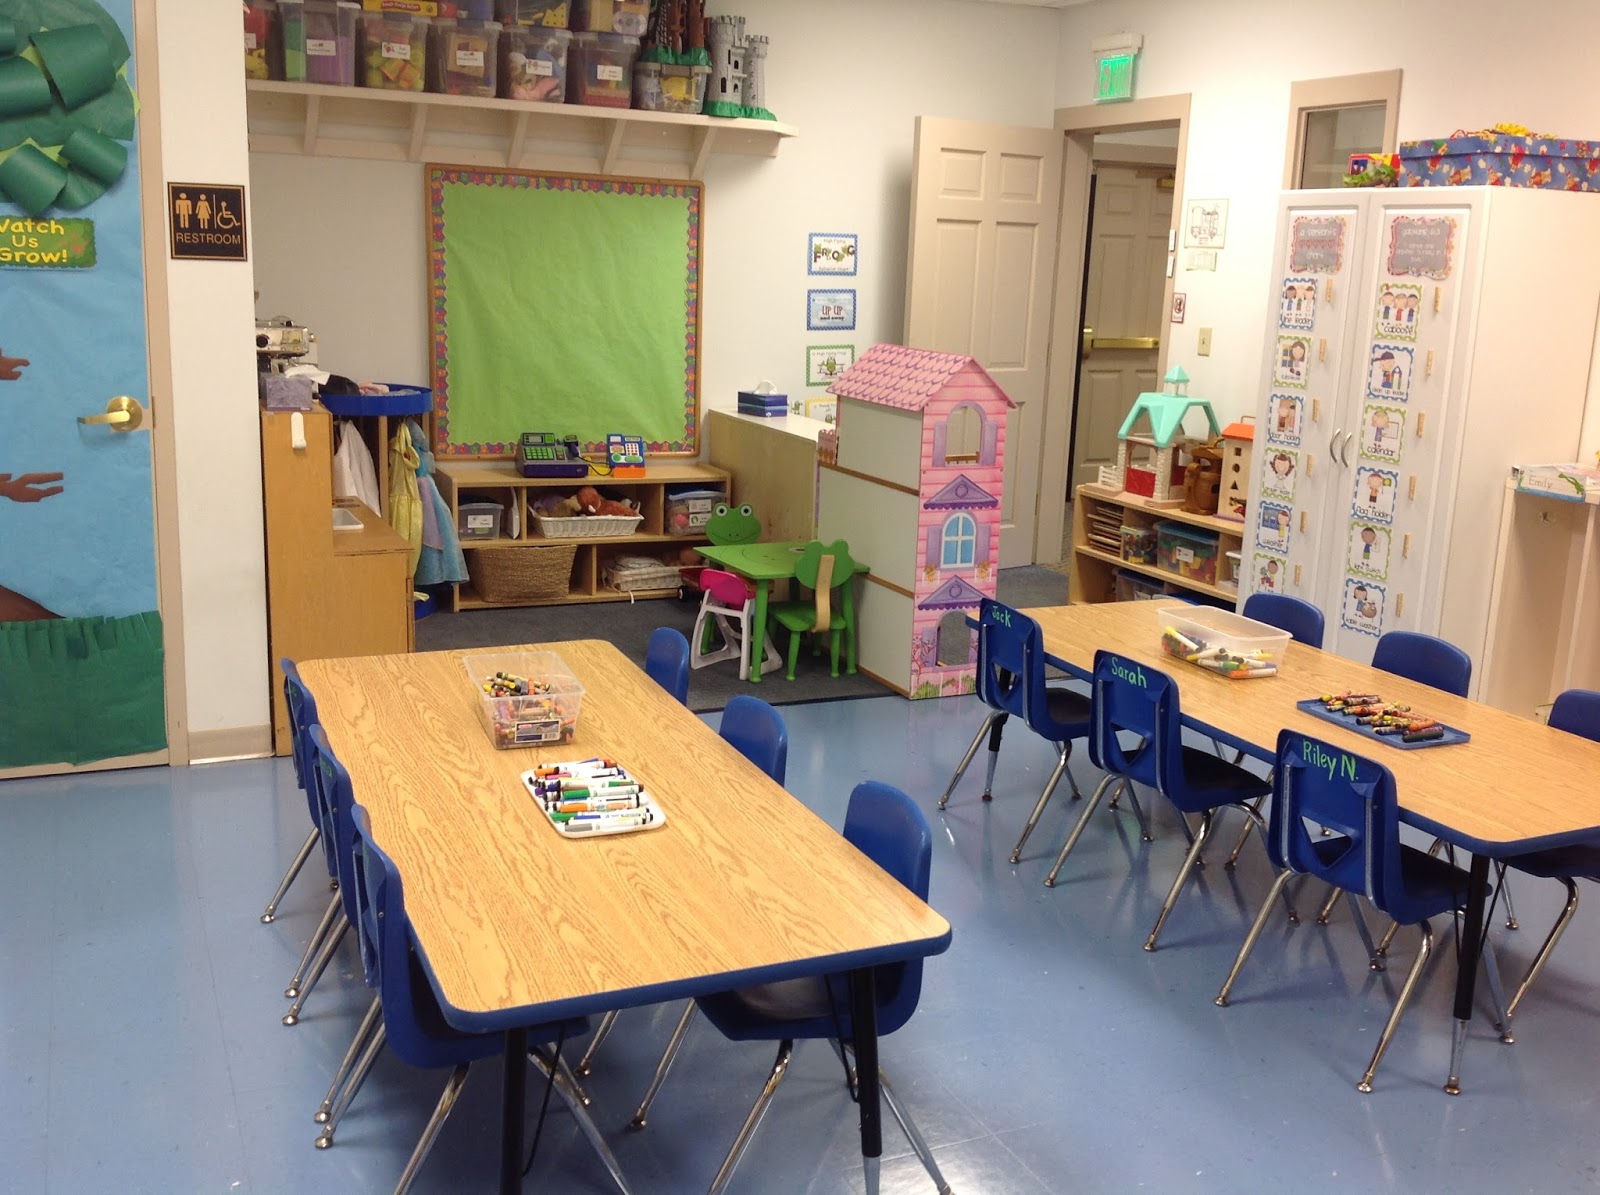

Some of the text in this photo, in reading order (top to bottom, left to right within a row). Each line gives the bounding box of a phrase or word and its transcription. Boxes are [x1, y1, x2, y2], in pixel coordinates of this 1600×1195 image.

[12, 235, 39, 248] Us
[176, 232, 241, 245] RESTROOM
[0, 247, 68, 263] Grow!
[813, 245, 856, 263] FROG
[822, 305, 844, 316] UP UP
[1367, 446, 1395, 457] calendar
[992, 605, 1012, 628] Jack
[1111, 656, 1148, 689] Sarah
[1303, 738, 1337, 781] Riley
